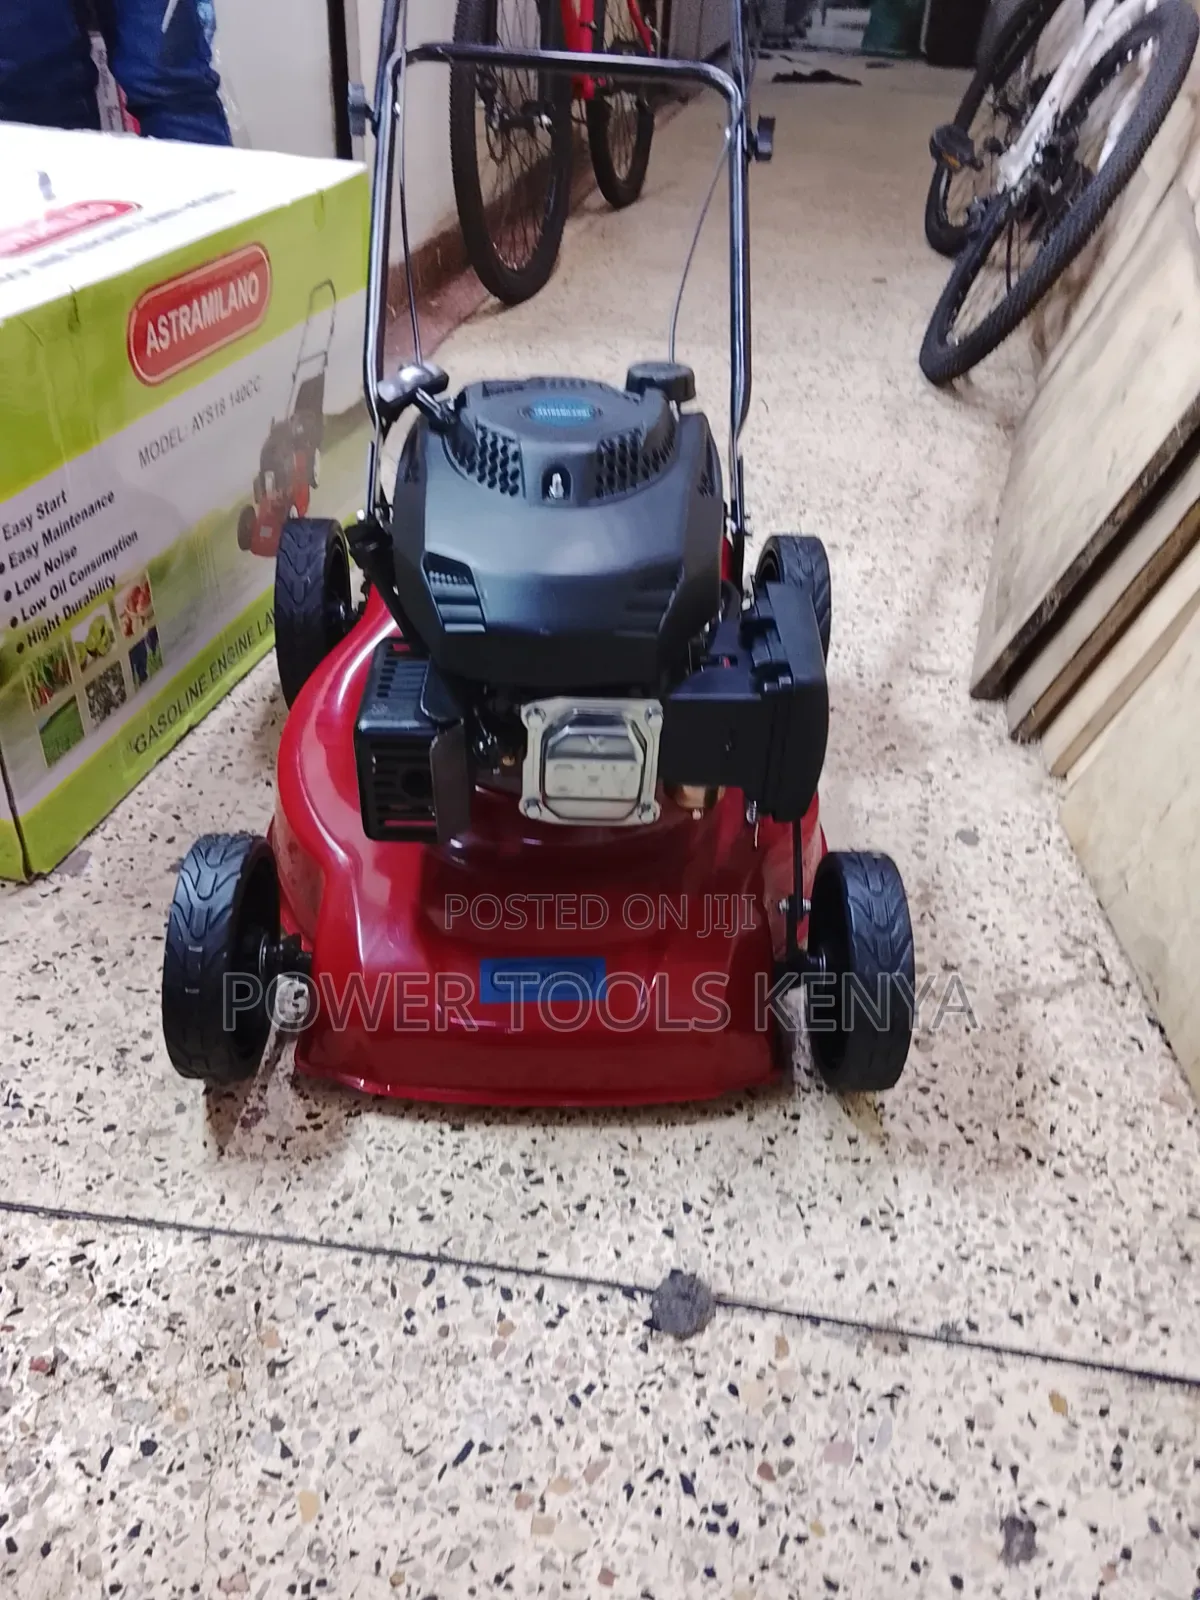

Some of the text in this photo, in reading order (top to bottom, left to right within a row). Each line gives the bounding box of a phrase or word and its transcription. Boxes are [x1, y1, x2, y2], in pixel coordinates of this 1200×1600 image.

[145, 271, 260, 357] ASTRAMILANO
[2, 490, 68, 541] Easy Start
[8, 491, 115, 569] Easy Maintenance
[15, 545, 78, 596] Low Noise
[21, 530, 139, 622] Low Oil Consumption
[27, 576, 116, 648] Hight Durability
[209, 626, 256, 682] ENGINE
